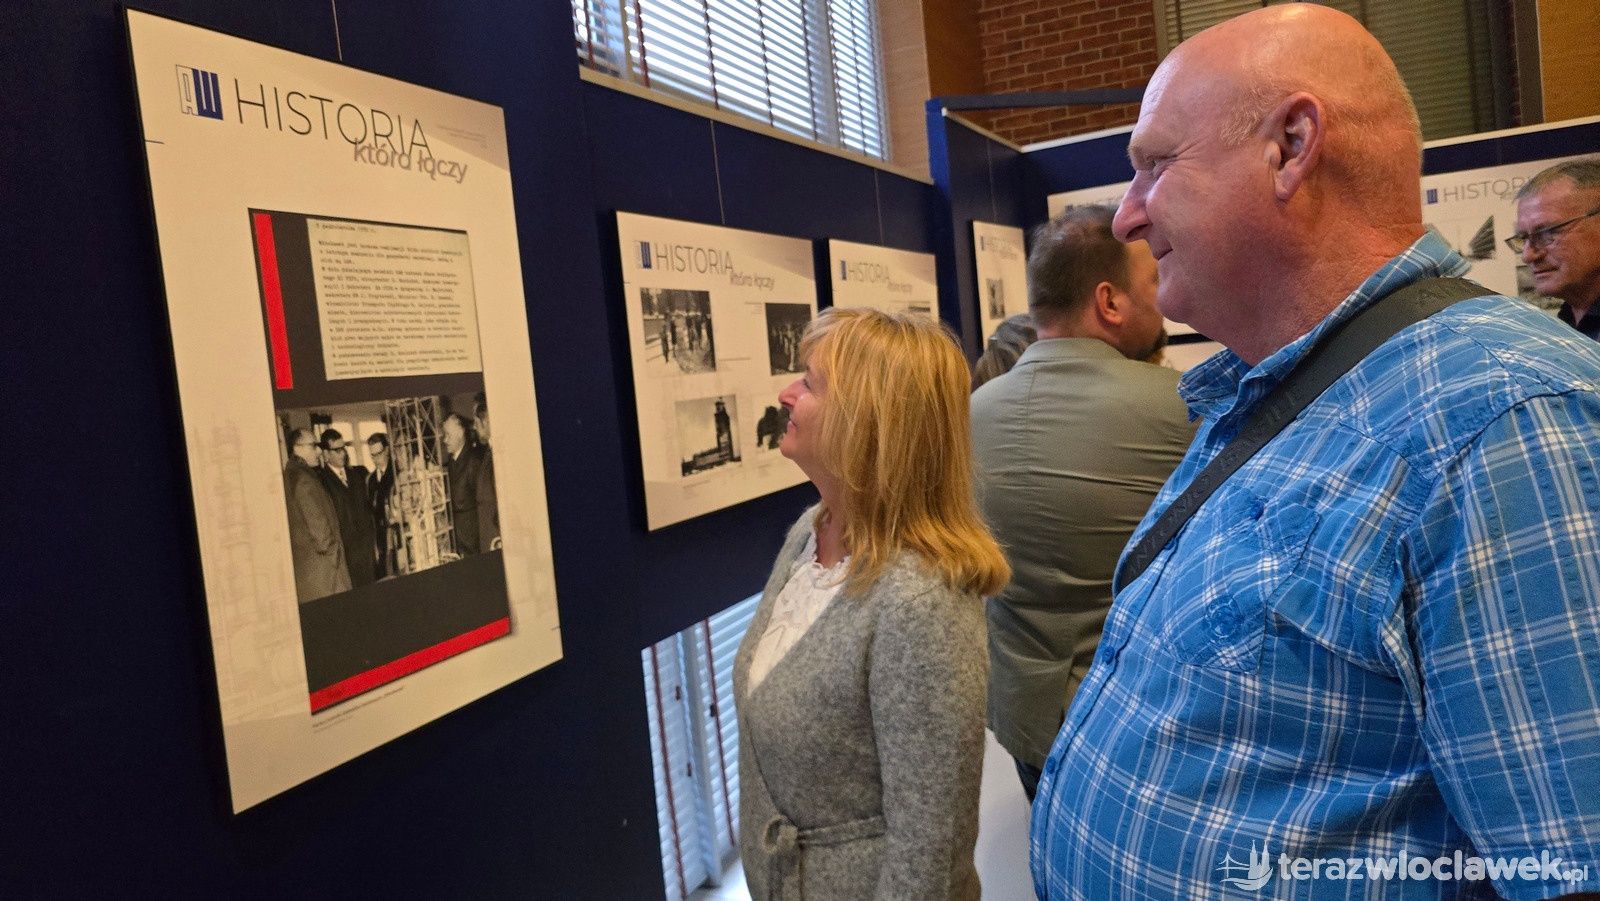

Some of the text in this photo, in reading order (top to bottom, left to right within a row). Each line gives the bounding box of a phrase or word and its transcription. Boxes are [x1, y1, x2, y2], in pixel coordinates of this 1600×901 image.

[234, 78, 433, 158] HISTORIA
[353, 137, 468, 184] która łączy
[1442, 176, 1531, 202] HISTOR
[654, 243, 734, 274] HISTORIA
